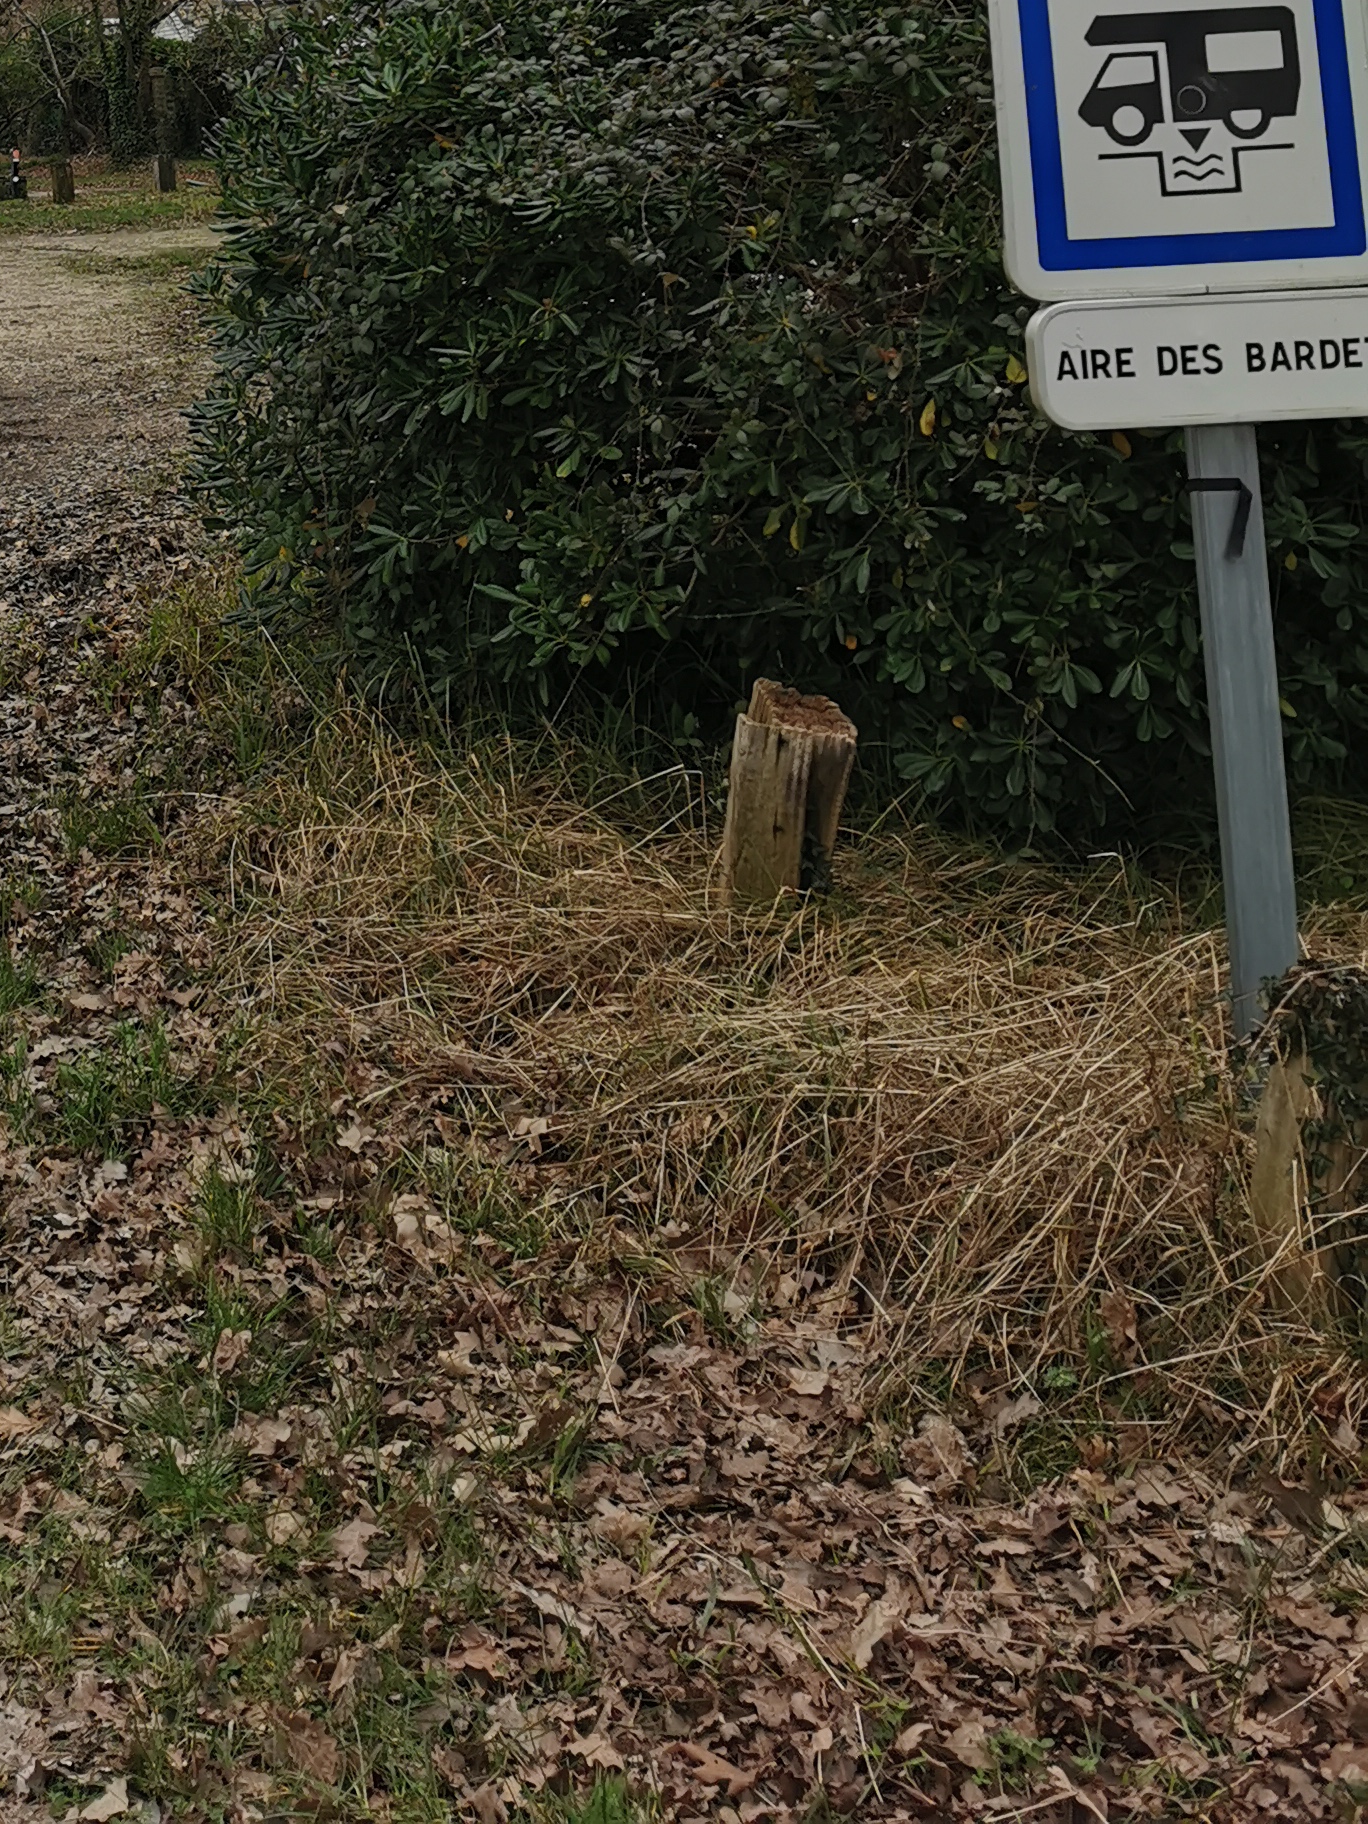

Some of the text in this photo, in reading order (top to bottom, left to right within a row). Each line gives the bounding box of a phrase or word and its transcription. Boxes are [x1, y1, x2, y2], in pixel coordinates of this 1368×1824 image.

[1057, 336, 1368, 381] AIRE DES BARDE
